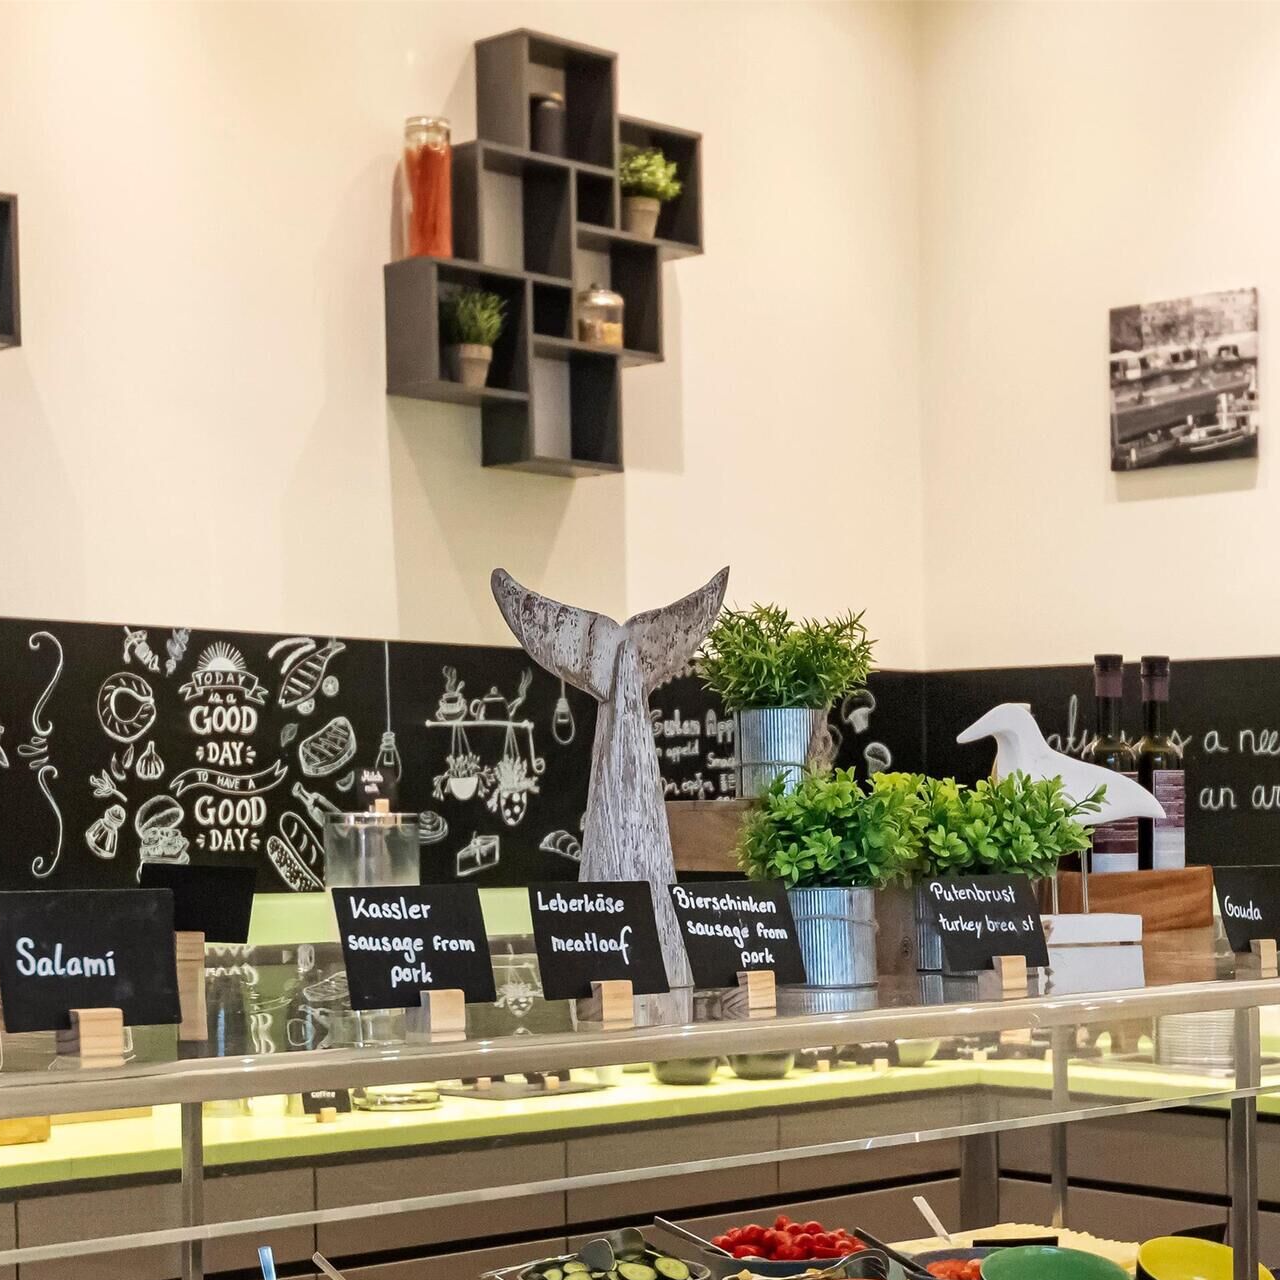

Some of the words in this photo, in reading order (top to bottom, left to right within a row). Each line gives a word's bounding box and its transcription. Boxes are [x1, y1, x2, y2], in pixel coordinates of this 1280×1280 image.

[196, 672, 246, 686] TODAY
[208, 689, 223, 703] is
[226, 694, 237, 703] a
[189, 705, 258, 735] GOOD
[1203, 730, 1229, 752] a
[207, 742, 245, 766] DAY
[197, 771, 209, 782] TO
[217, 775, 241, 790] HAVE
[248, 777, 256, 790] A
[195, 795, 267, 825] GOOD
[1199, 786, 1237, 810] an
[209, 829, 249, 851] DAY
[537, 891, 625, 914] Leberkäse
[673, 886, 776, 914] Bierschinken
[929, 881, 1016, 904] Putenbrust
[350, 896, 431, 920] Kassler
[1224, 895, 1262, 920] Gouda
[687, 920, 750, 949] sausage
[938, 913, 982, 939] turkey
[16, 936, 117, 978] Salami
[347, 933, 424, 964] sausage
[551, 925, 633, 965] meatloaf
[740, 948, 775, 969] pork
[390, 962, 433, 988] pork
